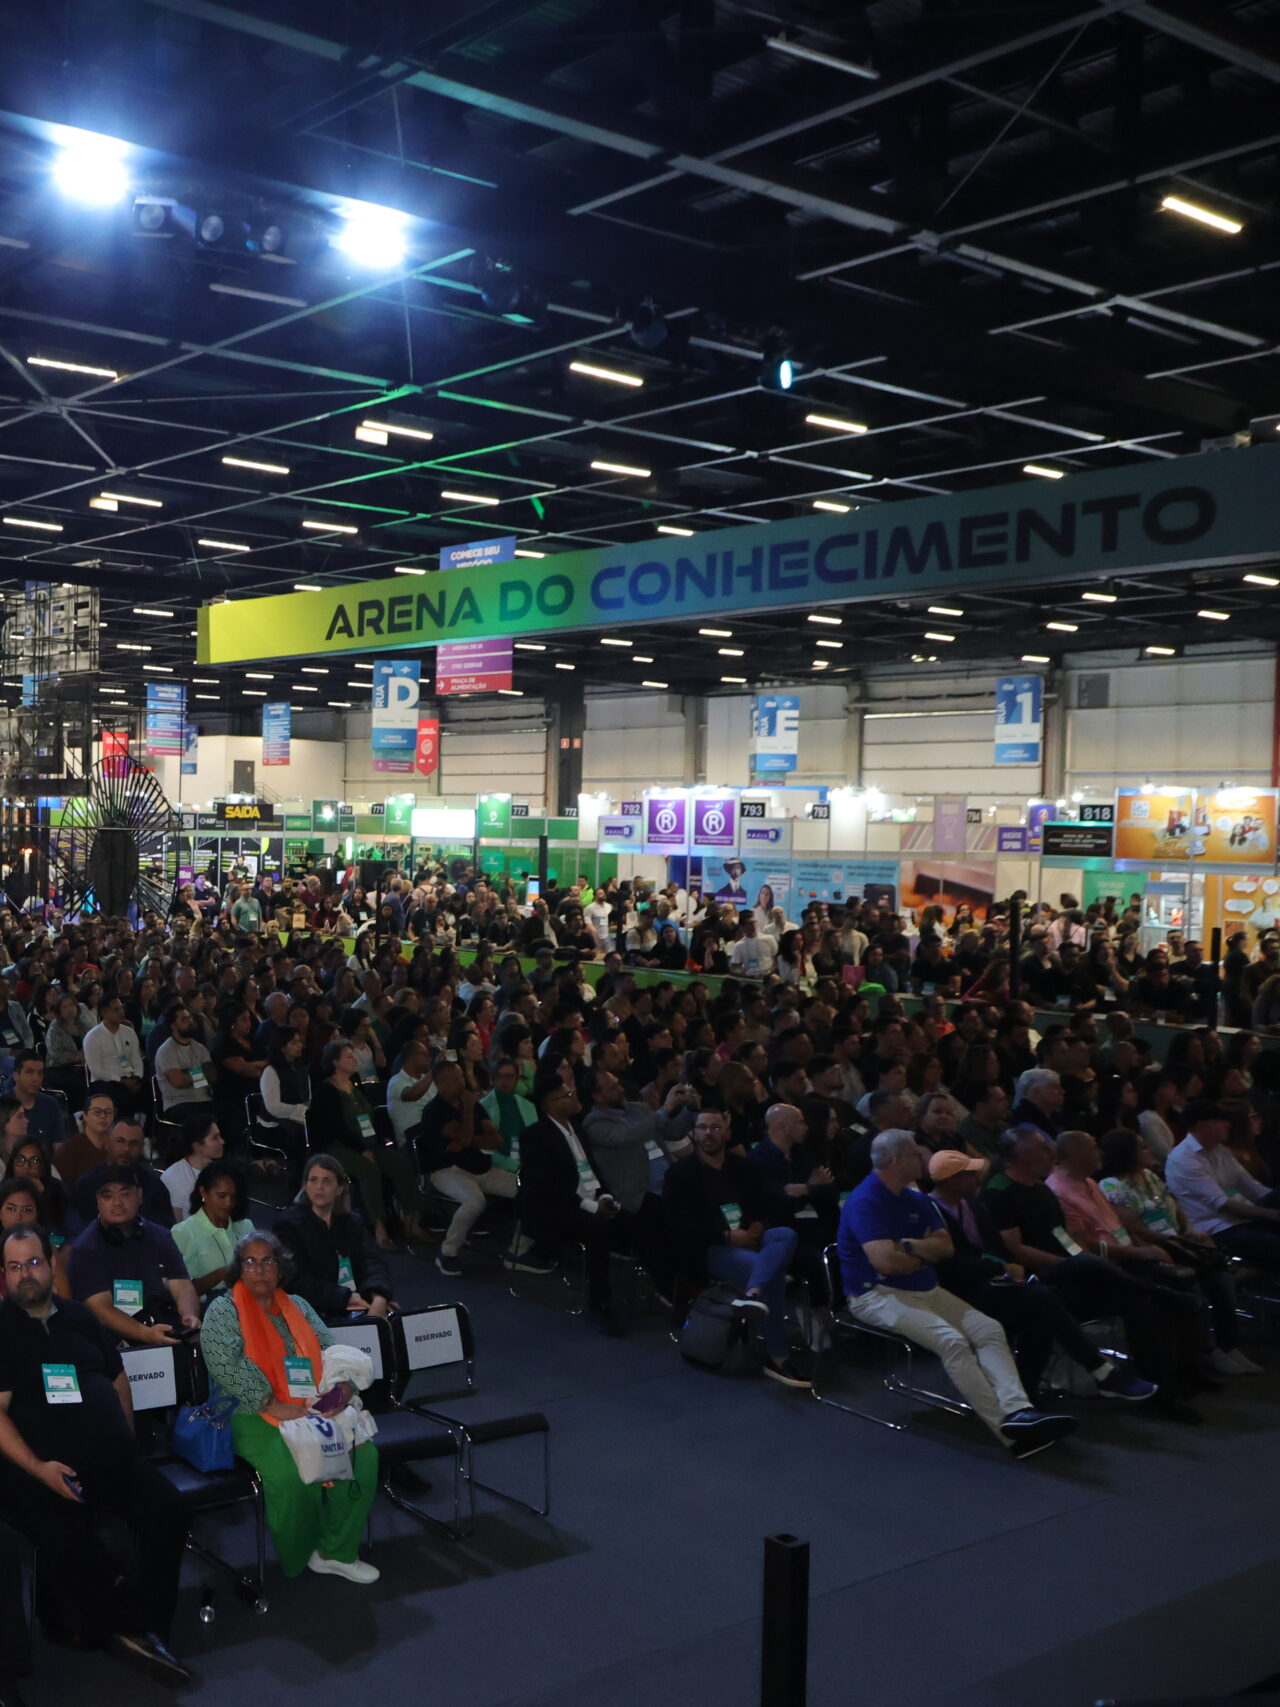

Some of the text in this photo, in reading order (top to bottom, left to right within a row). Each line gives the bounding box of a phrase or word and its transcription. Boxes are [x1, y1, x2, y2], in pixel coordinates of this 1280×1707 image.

[325, 485, 1217, 640] ARENA DO CONHECIMENTO
[375, 684, 385, 708] RUA
[388, 676, 420, 709] D
[1015, 692, 1033, 724] 1
[513, 806, 527, 816] 772
[623, 803, 641, 815] 792
[743, 805, 763, 817] 793
[1083, 807, 1111, 820] 818
[414, 1330, 453, 1343] RESERVADO
[128, 1371, 165, 1383] SERVADO
